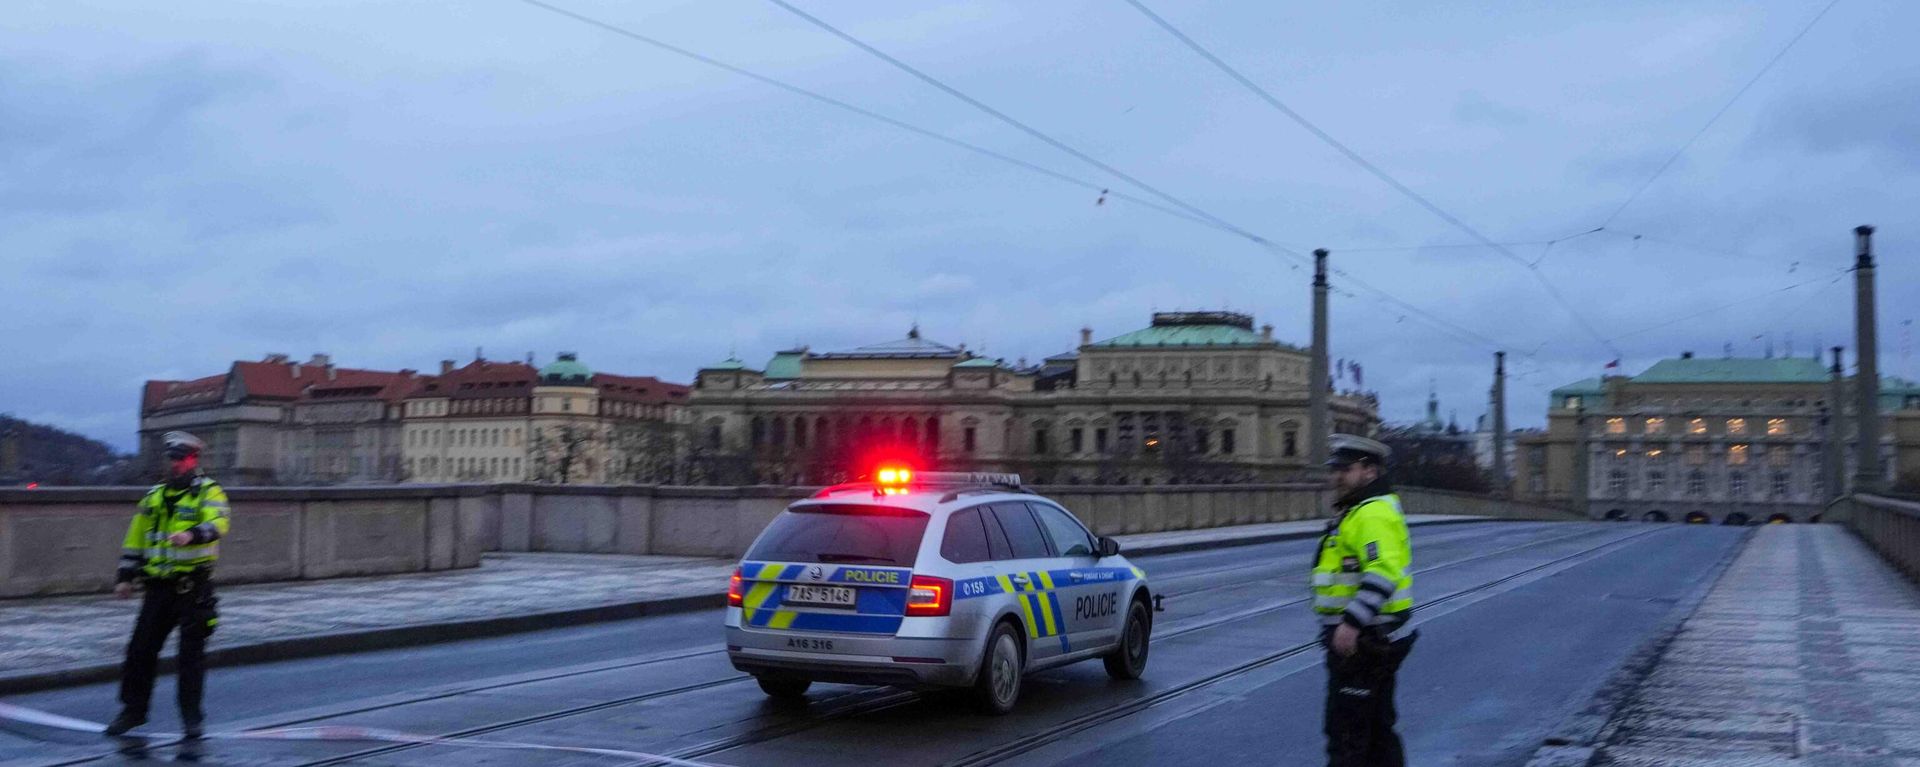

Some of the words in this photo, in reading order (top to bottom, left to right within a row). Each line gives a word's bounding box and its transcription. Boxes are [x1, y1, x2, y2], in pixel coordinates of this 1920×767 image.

[845, 569, 899, 583] POLICIE
[970, 582, 985, 594] 158
[1075, 592, 1117, 620] POLICIE
[787, 638, 809, 649] A16
[811, 640, 833, 651] 316
